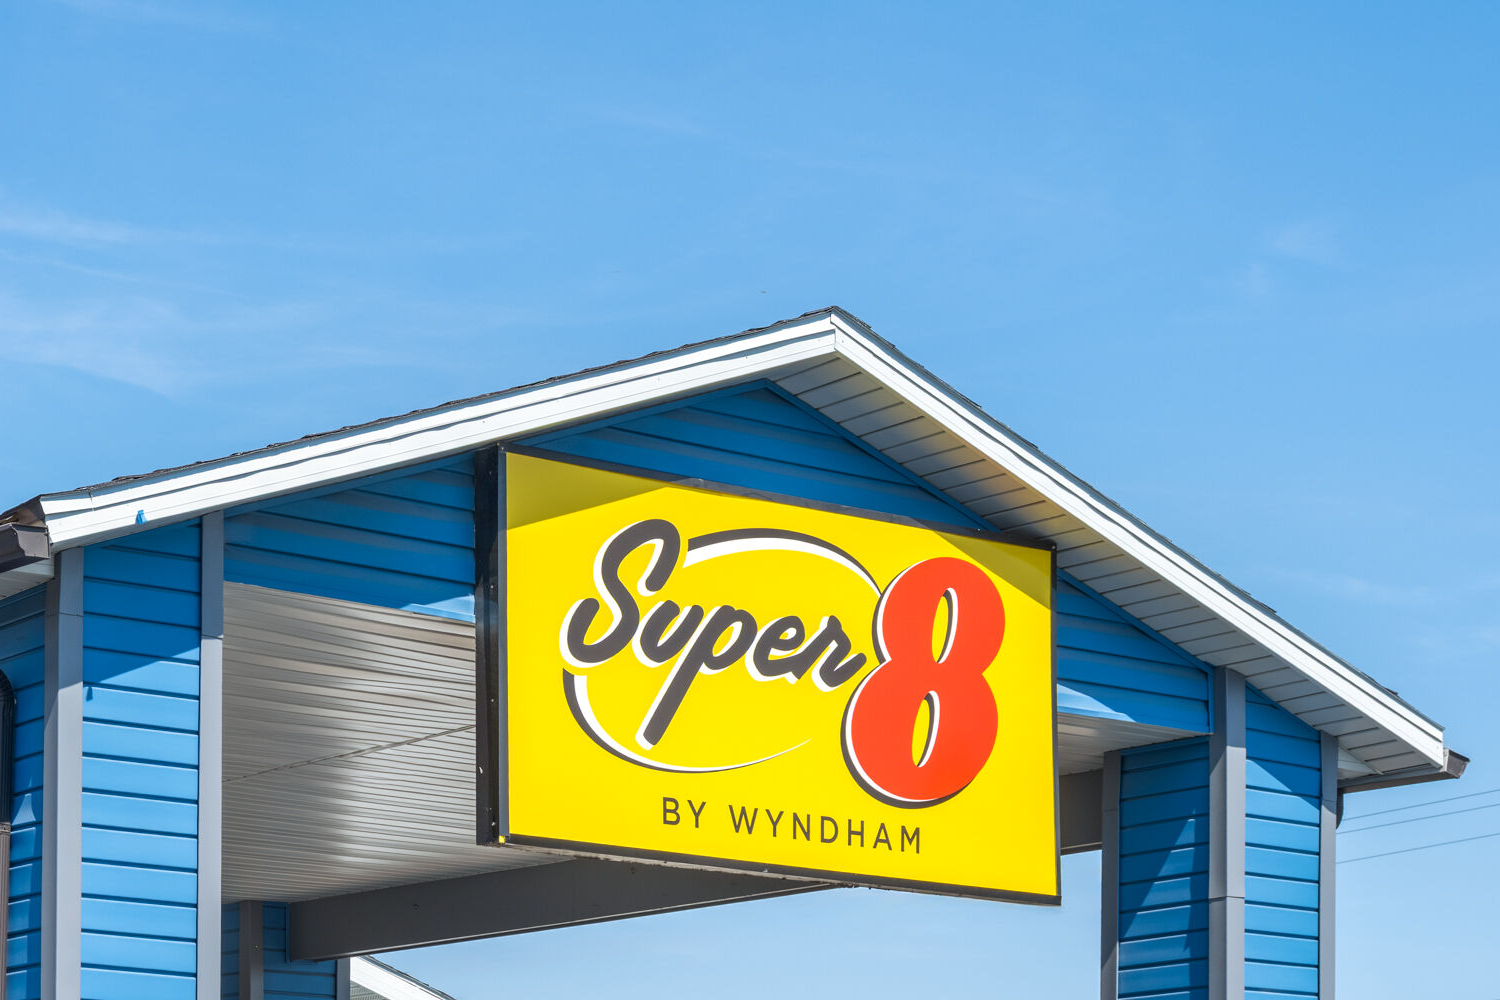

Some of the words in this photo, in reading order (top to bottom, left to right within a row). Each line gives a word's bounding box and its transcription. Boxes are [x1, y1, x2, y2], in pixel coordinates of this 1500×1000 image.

[560, 518, 867, 749] Super
[841, 556, 1006, 809] 8
[662, 796, 707, 829] BY
[728, 804, 921, 855] WYNDHAM
